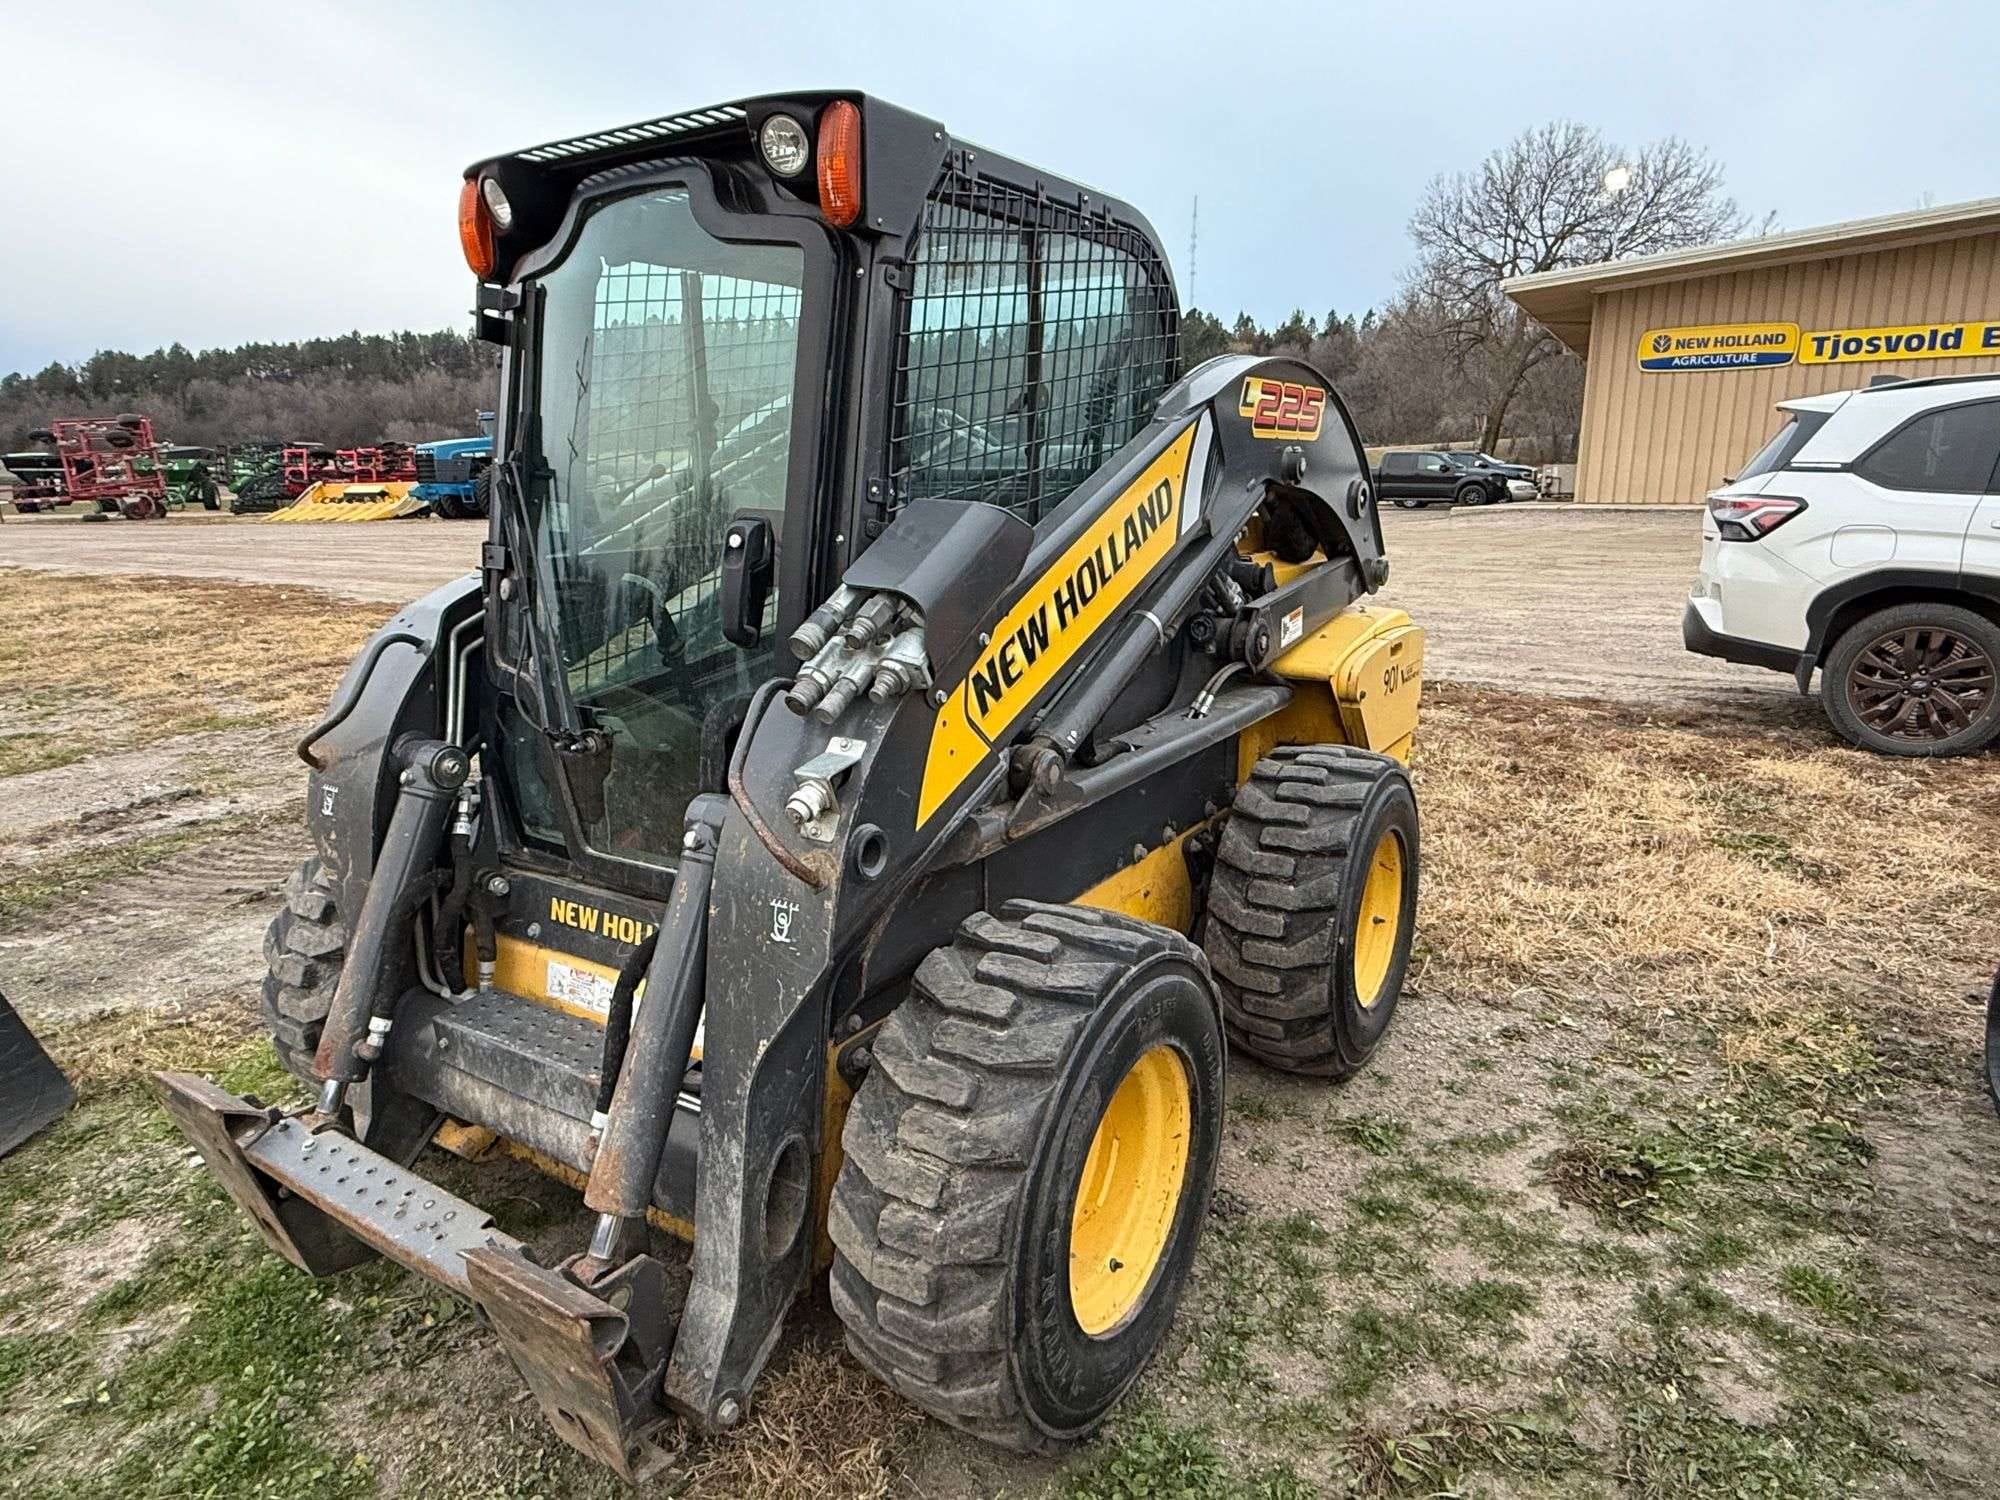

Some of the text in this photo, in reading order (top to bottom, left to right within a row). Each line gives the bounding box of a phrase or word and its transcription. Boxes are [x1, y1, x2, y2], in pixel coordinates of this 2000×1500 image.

[1675, 333, 1786, 350] NEW HOLLAND
[1811, 328, 1964, 361] Tjosvold
[1672, 353, 1758, 366] AGRICULTURE
[1240, 380, 1324, 433] L225
[972, 477, 1173, 719] NEW HOLLAND
[551, 897, 599, 932] NEW
